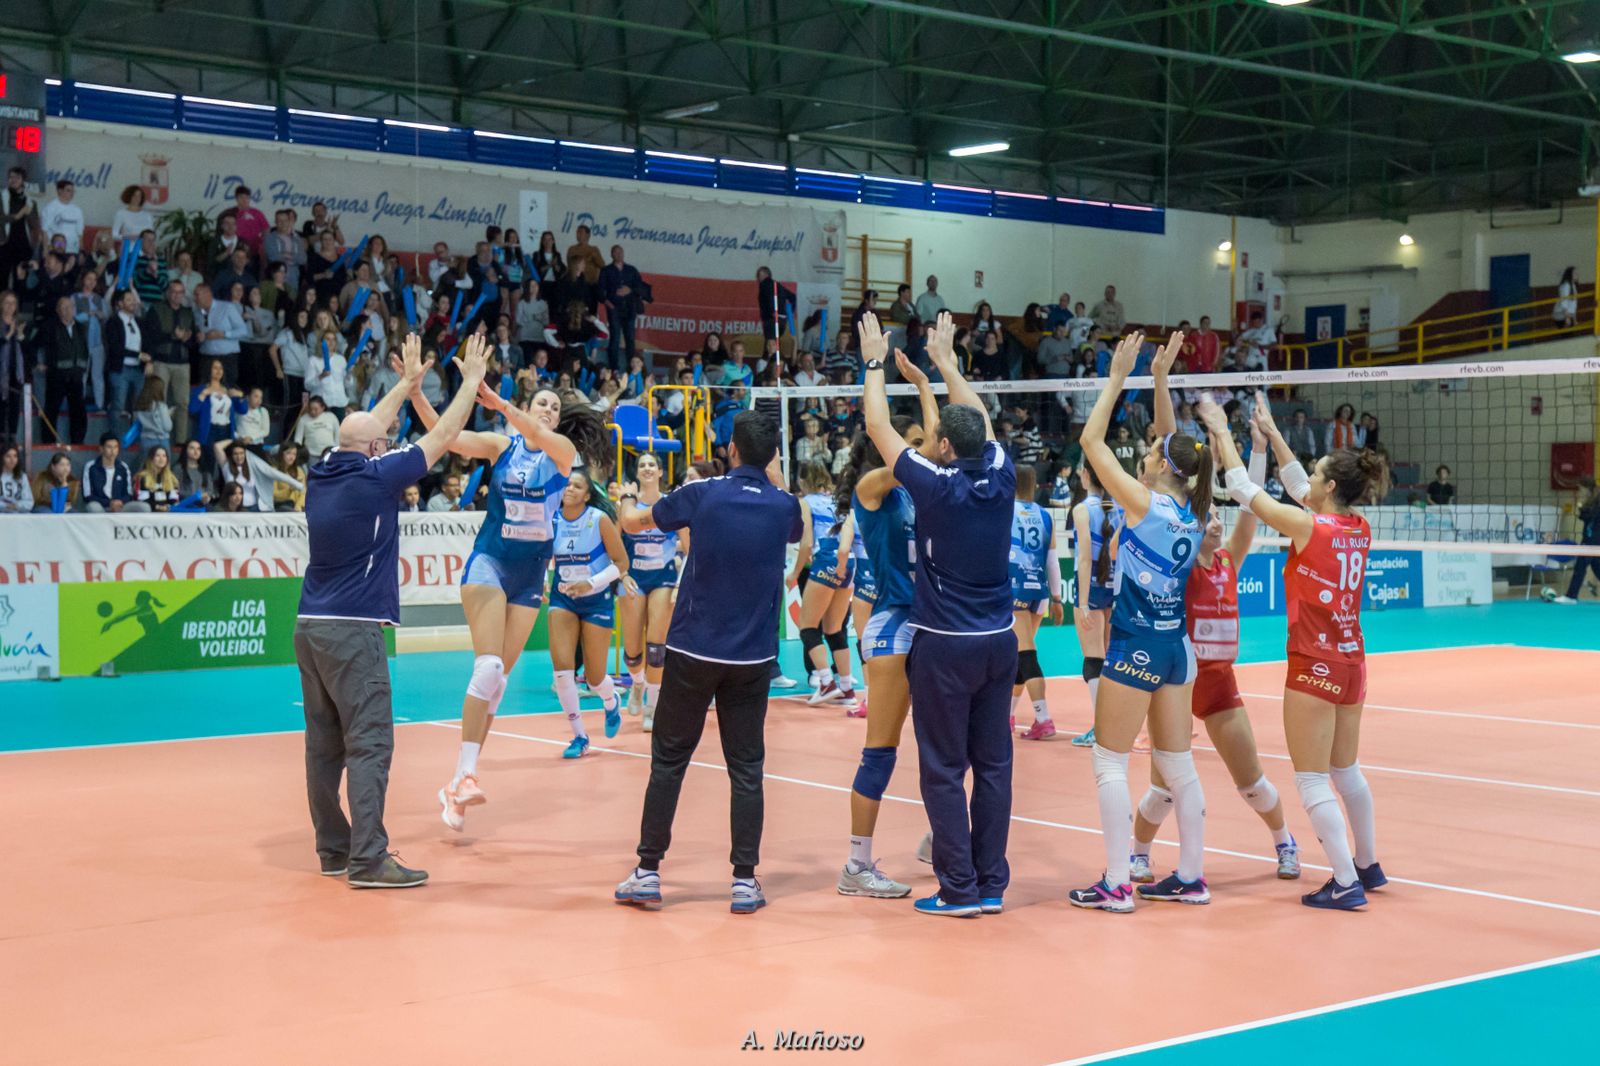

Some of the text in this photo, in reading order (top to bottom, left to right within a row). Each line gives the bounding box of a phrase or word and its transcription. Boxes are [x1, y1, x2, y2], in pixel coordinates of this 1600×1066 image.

[15, 126, 42, 153] 18
[372, 190, 426, 225] Juega
[612, 216, 694, 246] Hermanas
[695, 225, 739, 255] Juega
[699, 320, 722, 334] DOS
[1244, 374, 1283, 383] rfevb.com
[1347, 368, 1389, 379] rfevb.com
[1460, 364, 1504, 375] rfevb.com
[517, 471, 526, 485] 3
[112, 524, 188, 540] EXCMO.
[1018, 526, 1041, 551] 13
[566, 539, 575, 552] 4
[1349, 537, 1369, 548] RUIZ
[1169, 536, 1192, 576] 9
[1366, 557, 1409, 570] Fundación
[1336, 550, 1363, 591] 18
[1368, 581, 1409, 606] Cajasol
[231, 598, 266, 618] LIGA
[181, 618, 266, 640] IBERDROLA
[199, 638, 265, 658] VOLEIBOL
[1113, 660, 1161, 685] Divisa
[1295, 674, 1342, 695] Divisa
